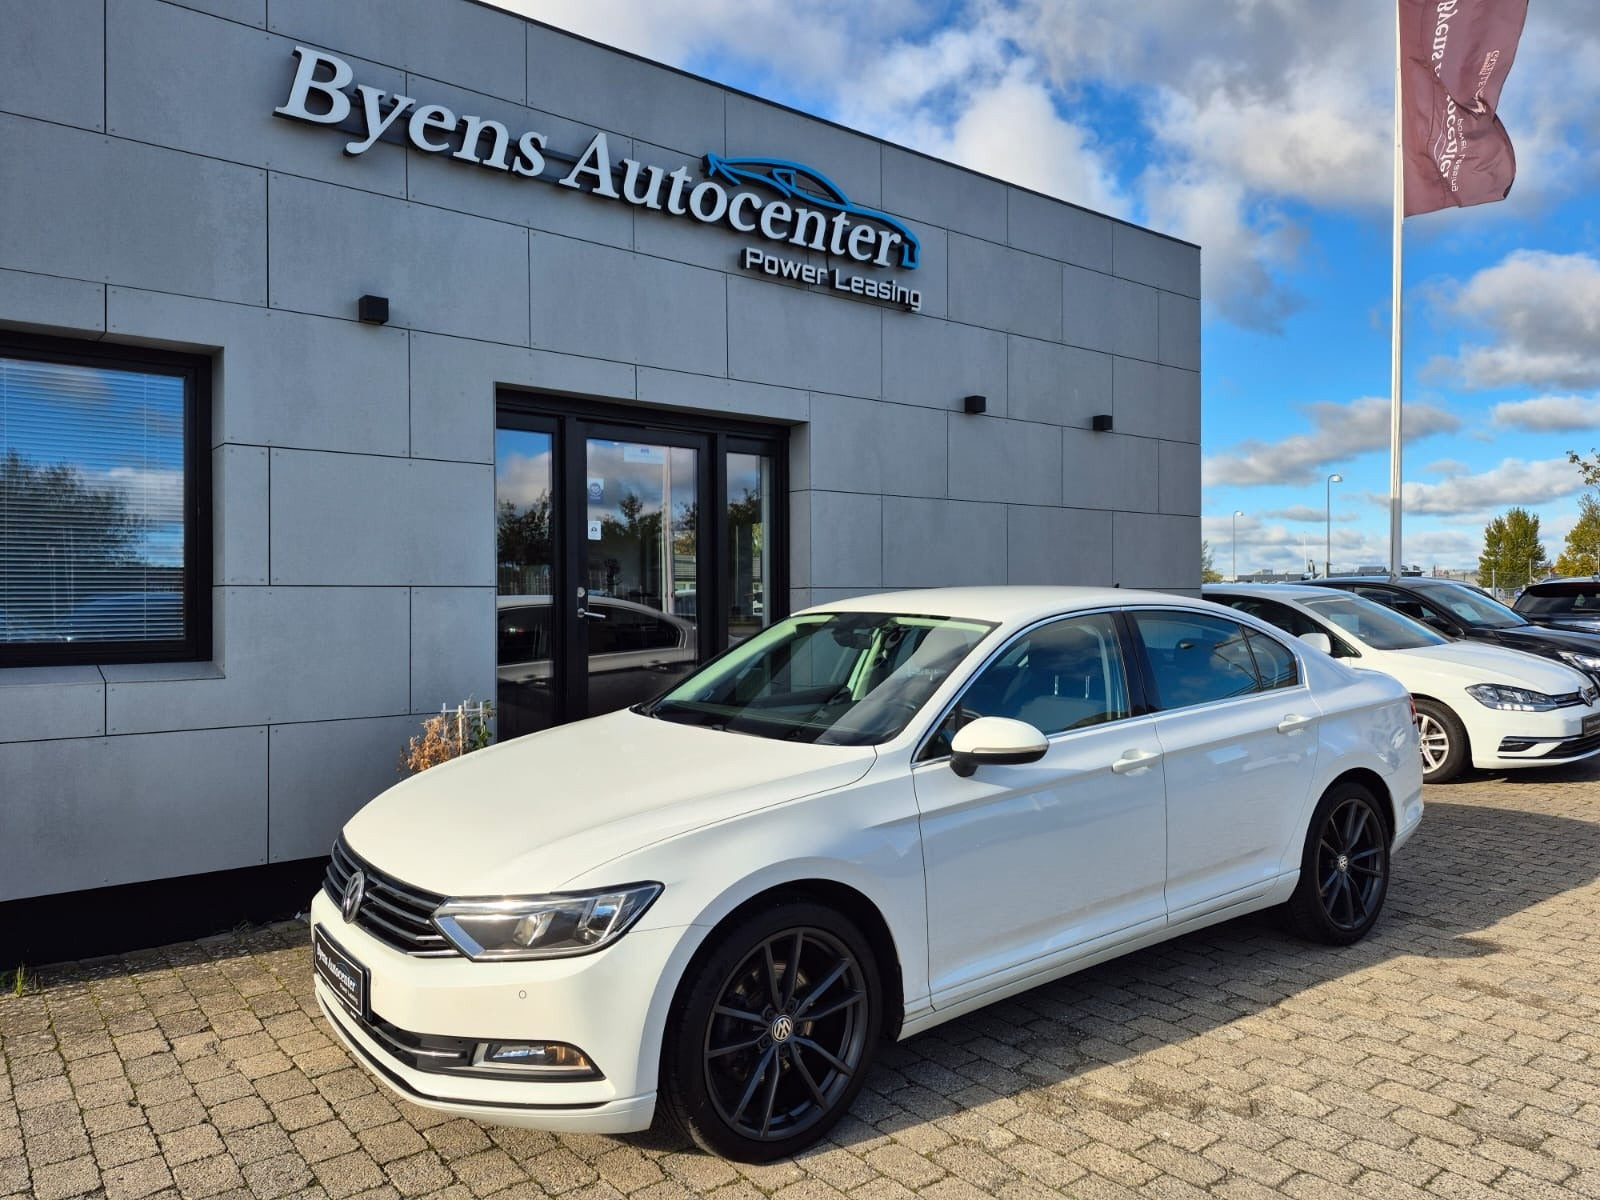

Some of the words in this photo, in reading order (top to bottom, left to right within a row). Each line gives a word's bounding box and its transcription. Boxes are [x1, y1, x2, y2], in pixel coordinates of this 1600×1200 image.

[272, 45, 548, 178] Byens
[559, 132, 901, 267] Autocenter
[745, 247, 828, 285] Power
[834, 268, 922, 311] Leasing
